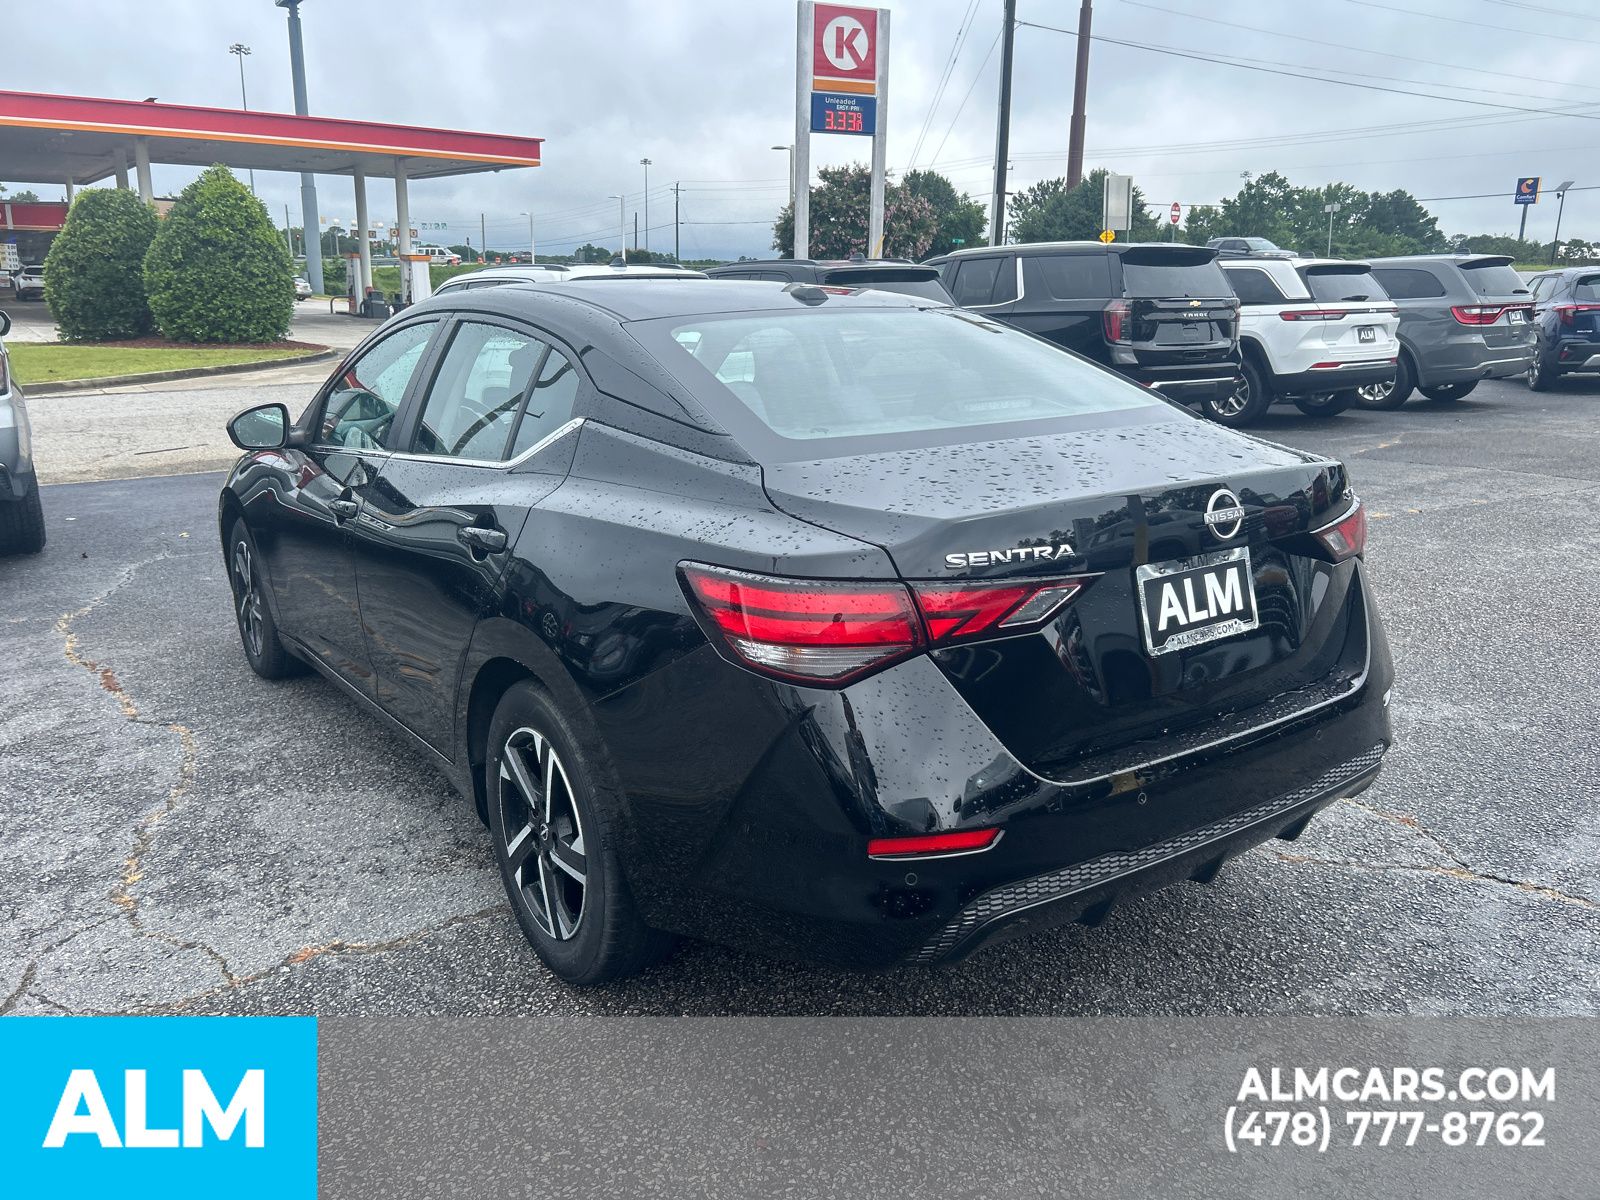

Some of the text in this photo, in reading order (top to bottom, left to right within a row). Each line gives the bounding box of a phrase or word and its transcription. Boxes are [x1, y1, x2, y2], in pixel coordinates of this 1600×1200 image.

[836, 26, 864, 67] K
[825, 97, 856, 105] Unleaded
[1361, 330, 1375, 340] ALM
[1206, 508, 1245, 523] NISSAN
[945, 544, 1076, 569] SENTRA
[1158, 567, 1244, 631] ALM
[1176, 622, 1235, 646] ALMCARS.COM
